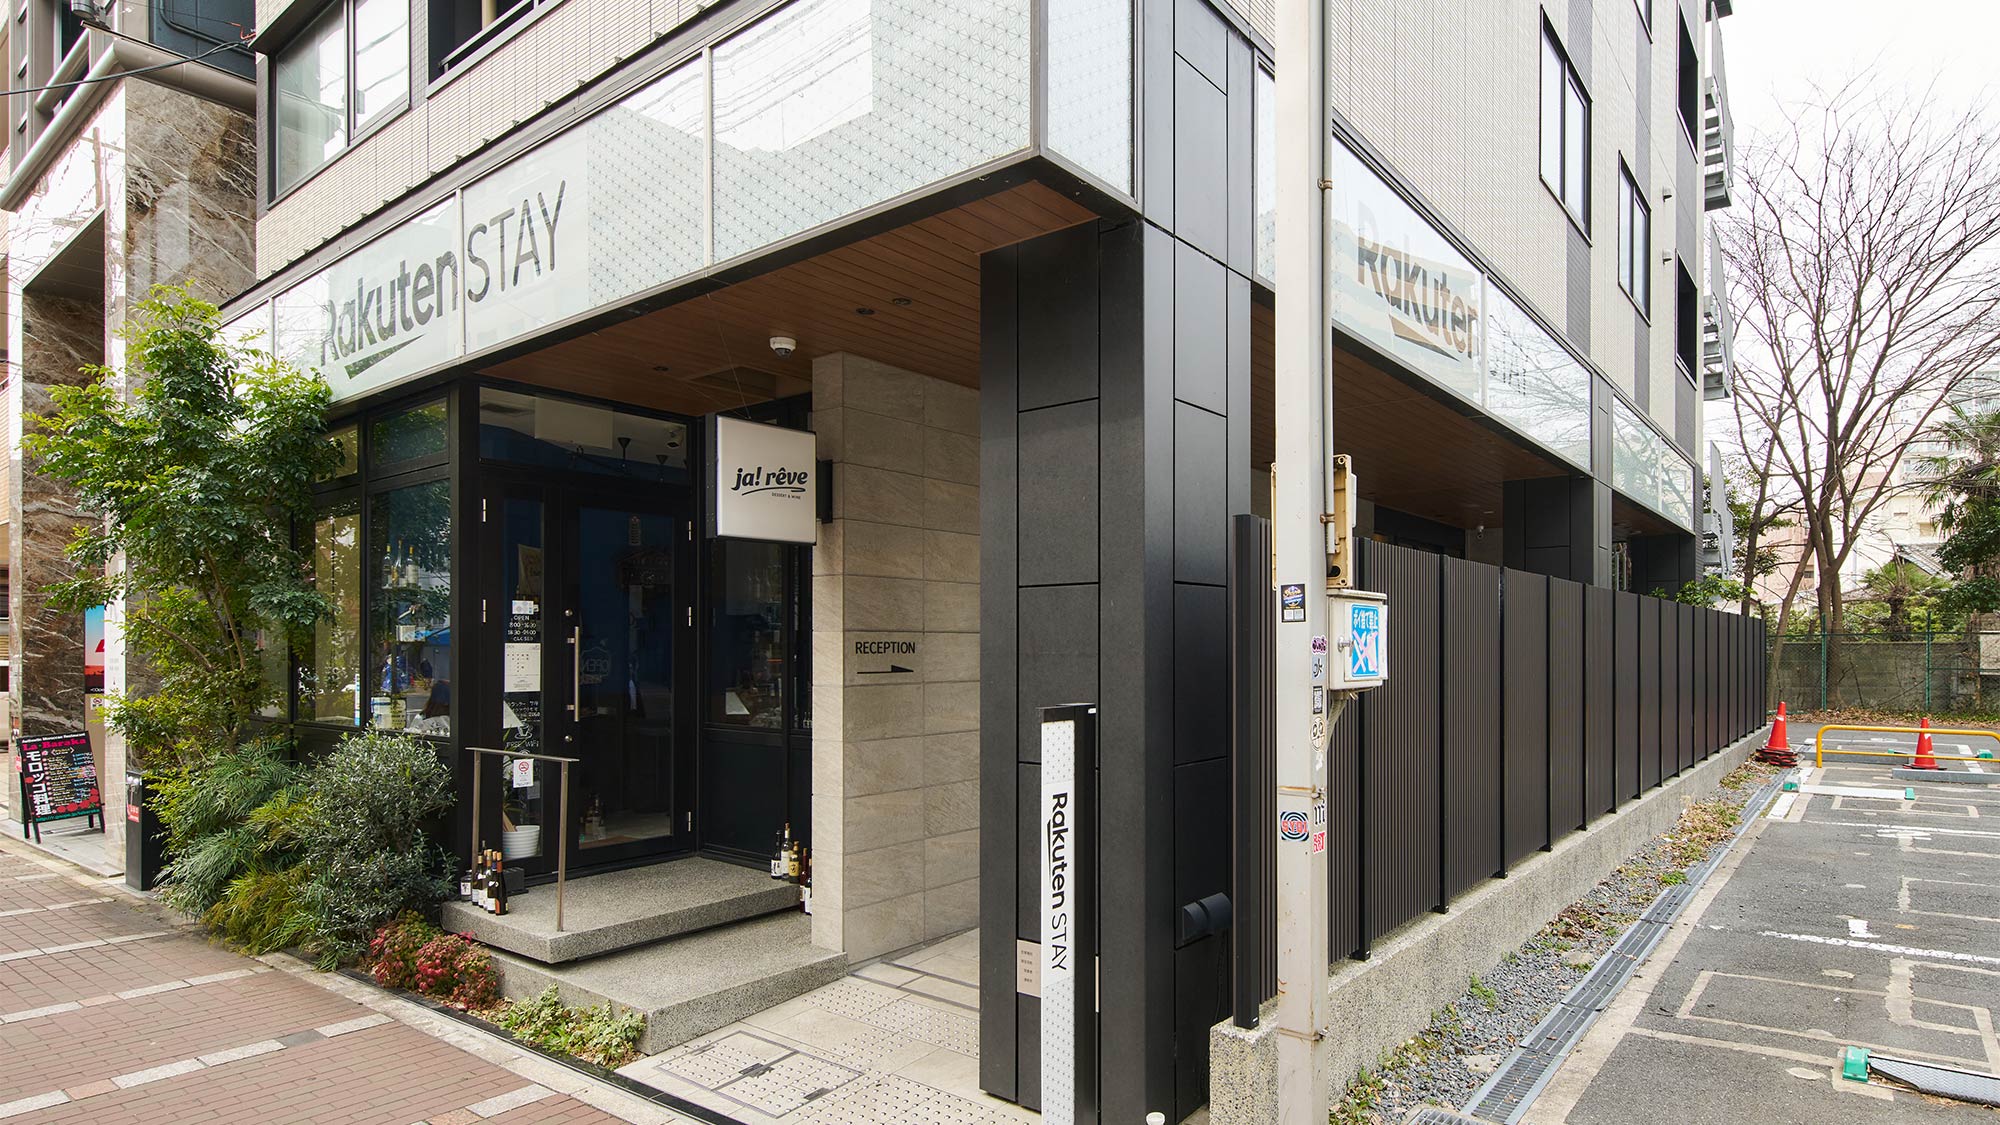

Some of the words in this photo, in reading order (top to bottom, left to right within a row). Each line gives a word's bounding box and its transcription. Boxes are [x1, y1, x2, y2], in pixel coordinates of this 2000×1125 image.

[320, 250, 458, 367] Rakuten
[467, 179, 576, 303] STAY
[731, 466, 762, 491] ja!
[765, 467, 809, 486] rêve
[855, 641, 916, 655] RECEPTION
[22, 743, 38, 751] La
[42, 738, 87, 749] Baraka
[26, 750, 52, 816] モロッコ料理
[1051, 792, 1069, 910] Rakuten
[1051, 912, 1068, 971] STAY
